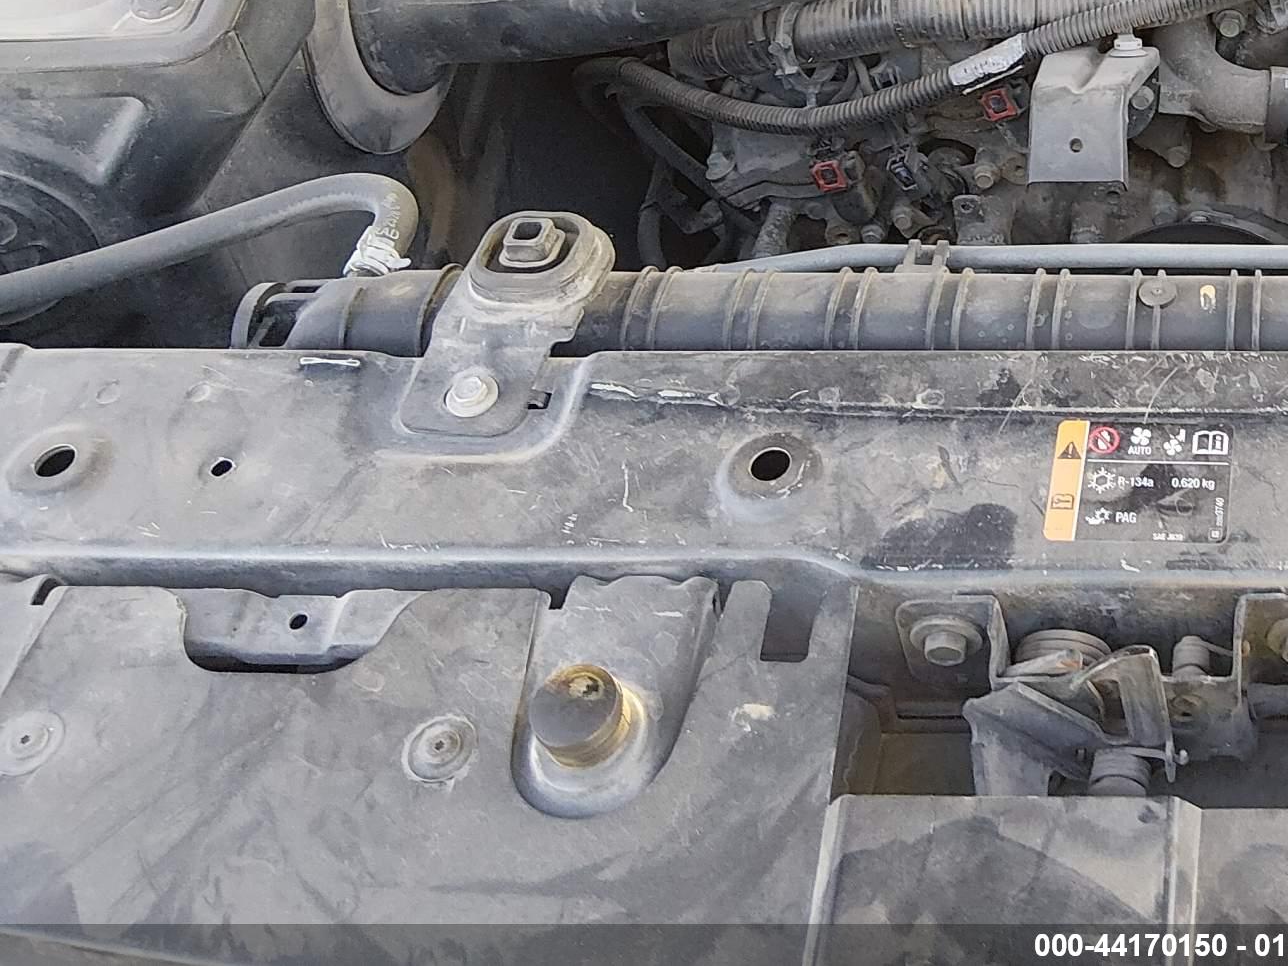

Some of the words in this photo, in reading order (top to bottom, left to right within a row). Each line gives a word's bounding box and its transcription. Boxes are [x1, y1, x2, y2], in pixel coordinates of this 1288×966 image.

[1127, 445, 1152, 455] AUTO
[1117, 477, 1154, 488] R-134a
[1171, 477, 1201, 488] 0.620
[1201, 478, 1216, 491] kg
[1115, 511, 1137, 524] PAG
